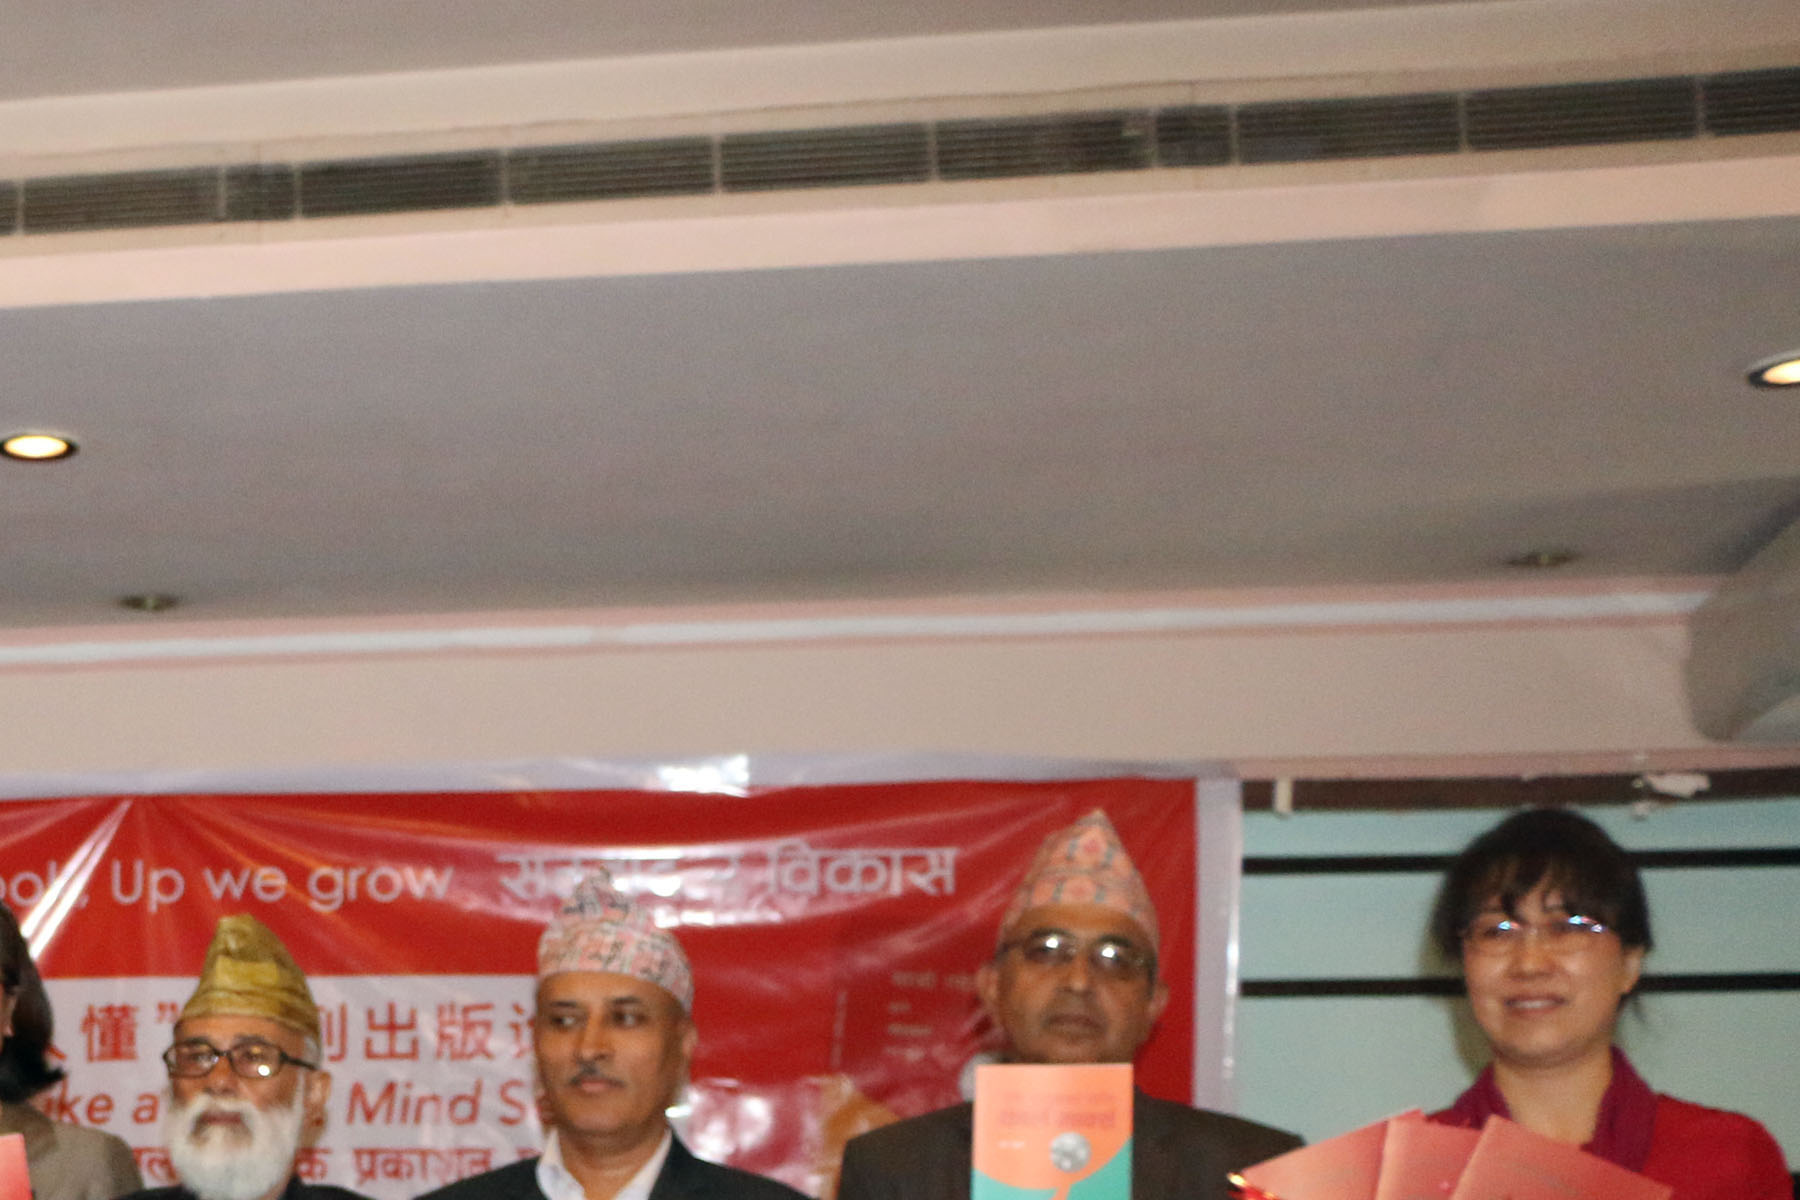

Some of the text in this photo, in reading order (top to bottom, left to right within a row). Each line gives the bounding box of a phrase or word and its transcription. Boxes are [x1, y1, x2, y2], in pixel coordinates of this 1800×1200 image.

[111, 858, 186, 914] Up
[202, 865, 289, 902] we
[307, 864, 455, 913] grow
[346, 1076, 483, 1126] Mind
